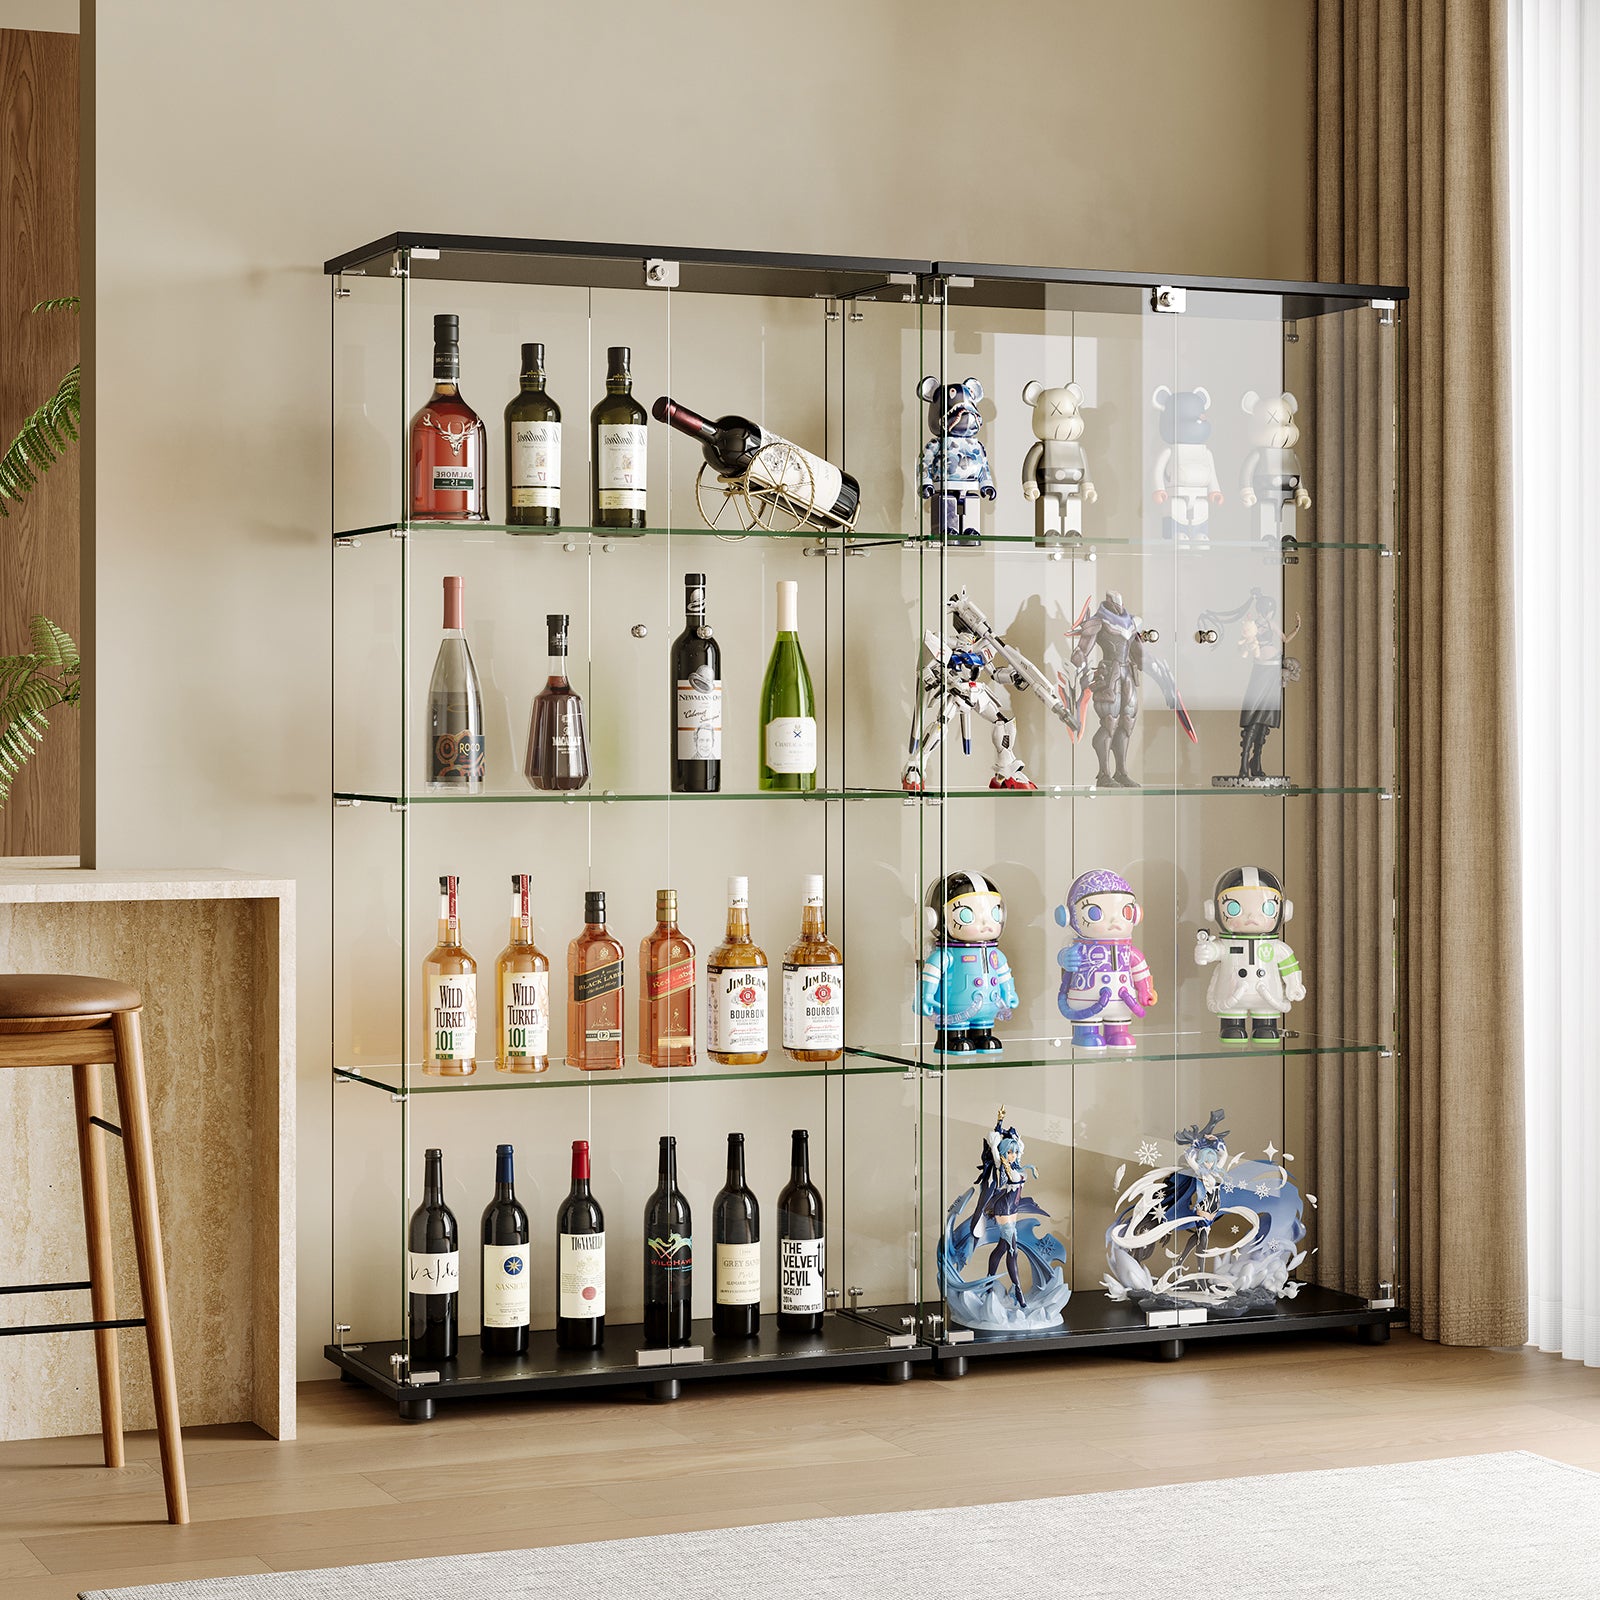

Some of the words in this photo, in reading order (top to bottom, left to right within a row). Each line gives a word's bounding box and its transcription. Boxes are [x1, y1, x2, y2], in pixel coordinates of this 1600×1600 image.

[578, 978, 601, 990] BLACK
[726, 978, 743, 994] JIM
[802, 975, 819, 991] JIM
[439, 986, 462, 1008] WILD
[512, 983, 535, 1006] WILD
[434, 1008, 467, 1028] TURKEY
[507, 1005, 540, 1026] TURKEY
[730, 1010, 764, 1019] BOURBON
[806, 1007, 839, 1016] BOURBON
[435, 1030, 454, 1051] 101
[508, 1028, 526, 1048] 101
[783, 1242, 802, 1254] THE
[783, 1254, 817, 1268] VELVET
[784, 1270, 810, 1286] DEVIL
[784, 1288, 802, 1296] MERLOT
